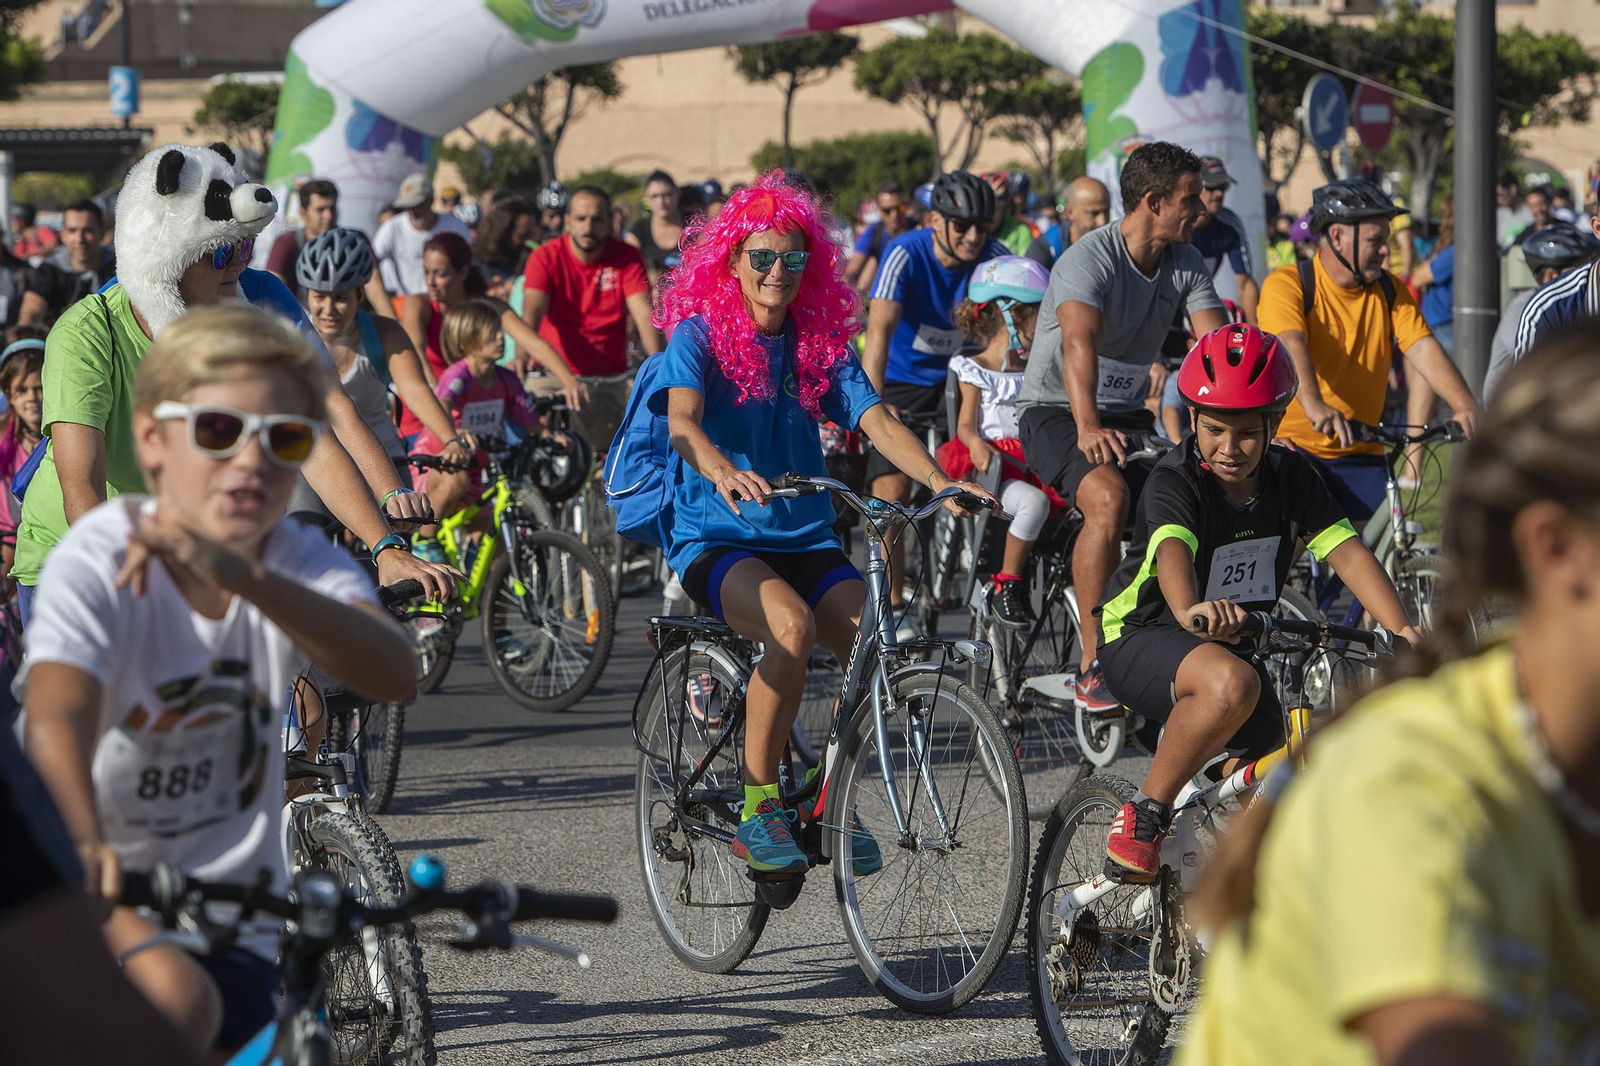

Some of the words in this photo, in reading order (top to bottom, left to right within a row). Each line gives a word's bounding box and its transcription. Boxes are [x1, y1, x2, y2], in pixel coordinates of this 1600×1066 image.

[109, 72, 131, 111] 2
[1103, 375, 1134, 390] 365
[1234, 529, 1255, 539] KIPSTA
[1221, 560, 1257, 587] 251
[138, 759, 213, 800] 888
